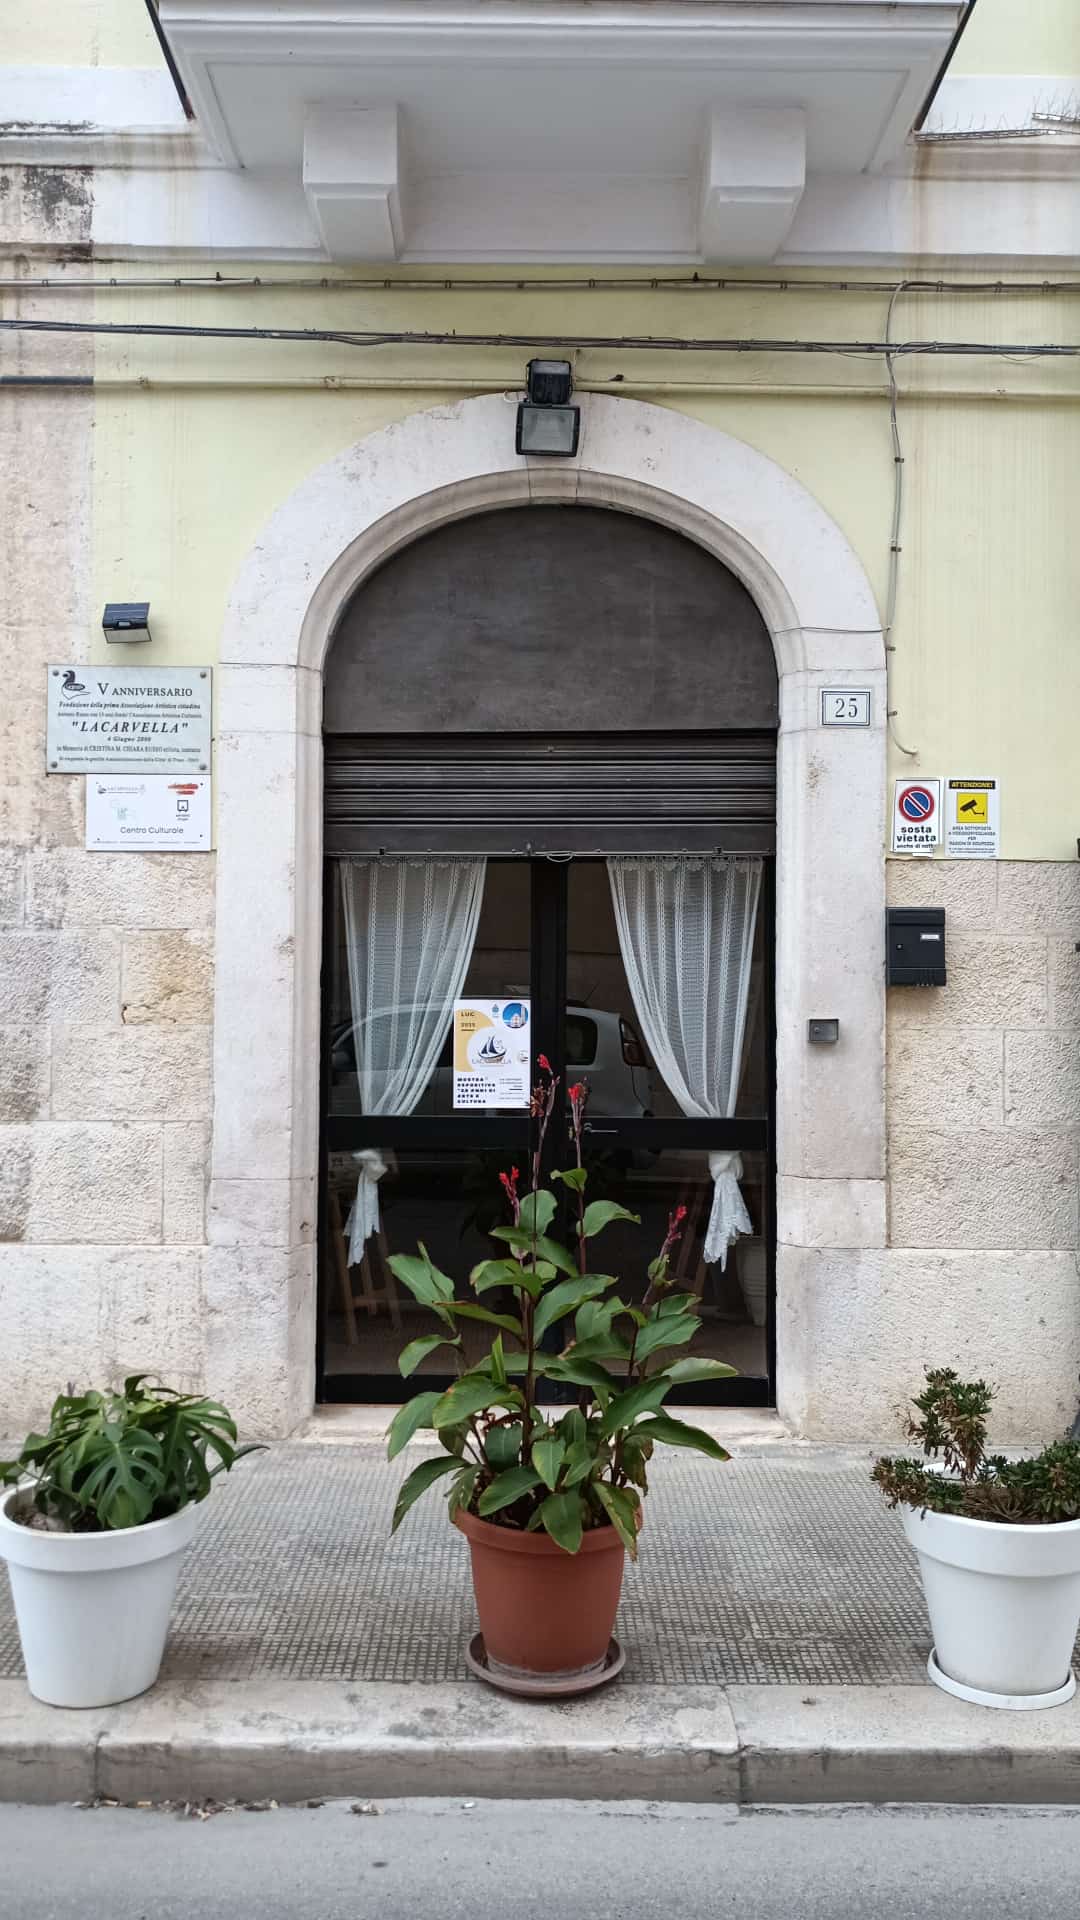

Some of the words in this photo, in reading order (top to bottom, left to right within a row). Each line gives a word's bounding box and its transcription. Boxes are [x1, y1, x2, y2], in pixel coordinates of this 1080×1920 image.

[98, 683, 109, 695] V
[112, 687, 192, 697] ANNIVERSARIO
[835, 698, 858, 718] 25
[72, 721, 188, 733] "LACARVELLA"
